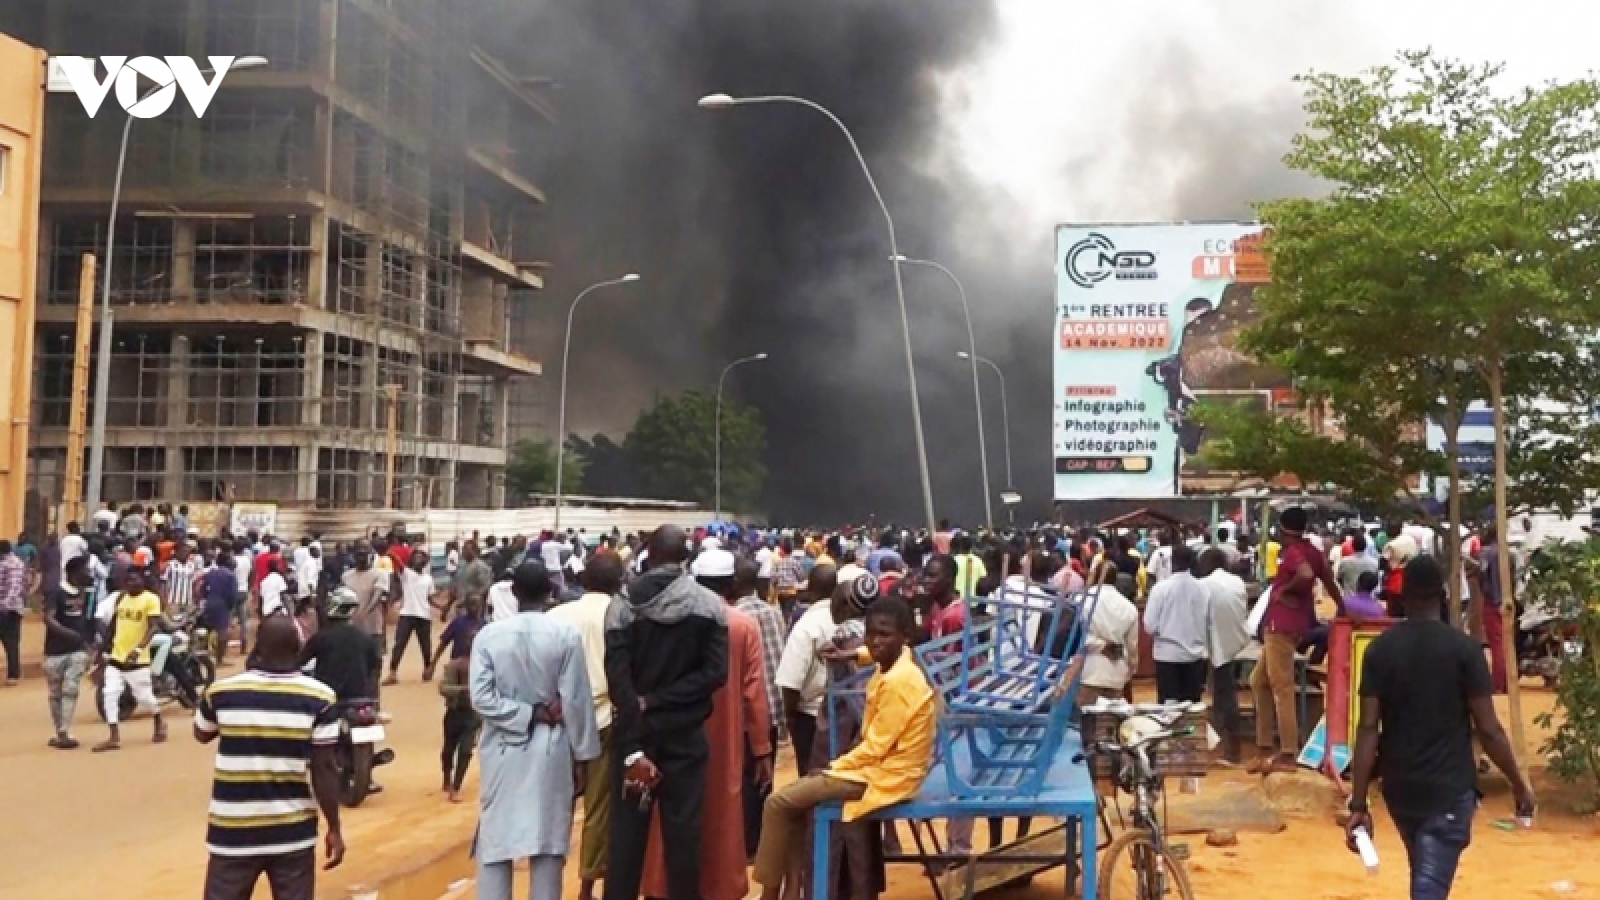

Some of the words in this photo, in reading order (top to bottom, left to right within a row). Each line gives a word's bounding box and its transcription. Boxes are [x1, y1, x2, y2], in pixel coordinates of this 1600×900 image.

[1063, 323, 1167, 336] ACADEMIQUE
[1129, 337, 1165, 348] 2022
[1065, 418, 1160, 434] Photographie
